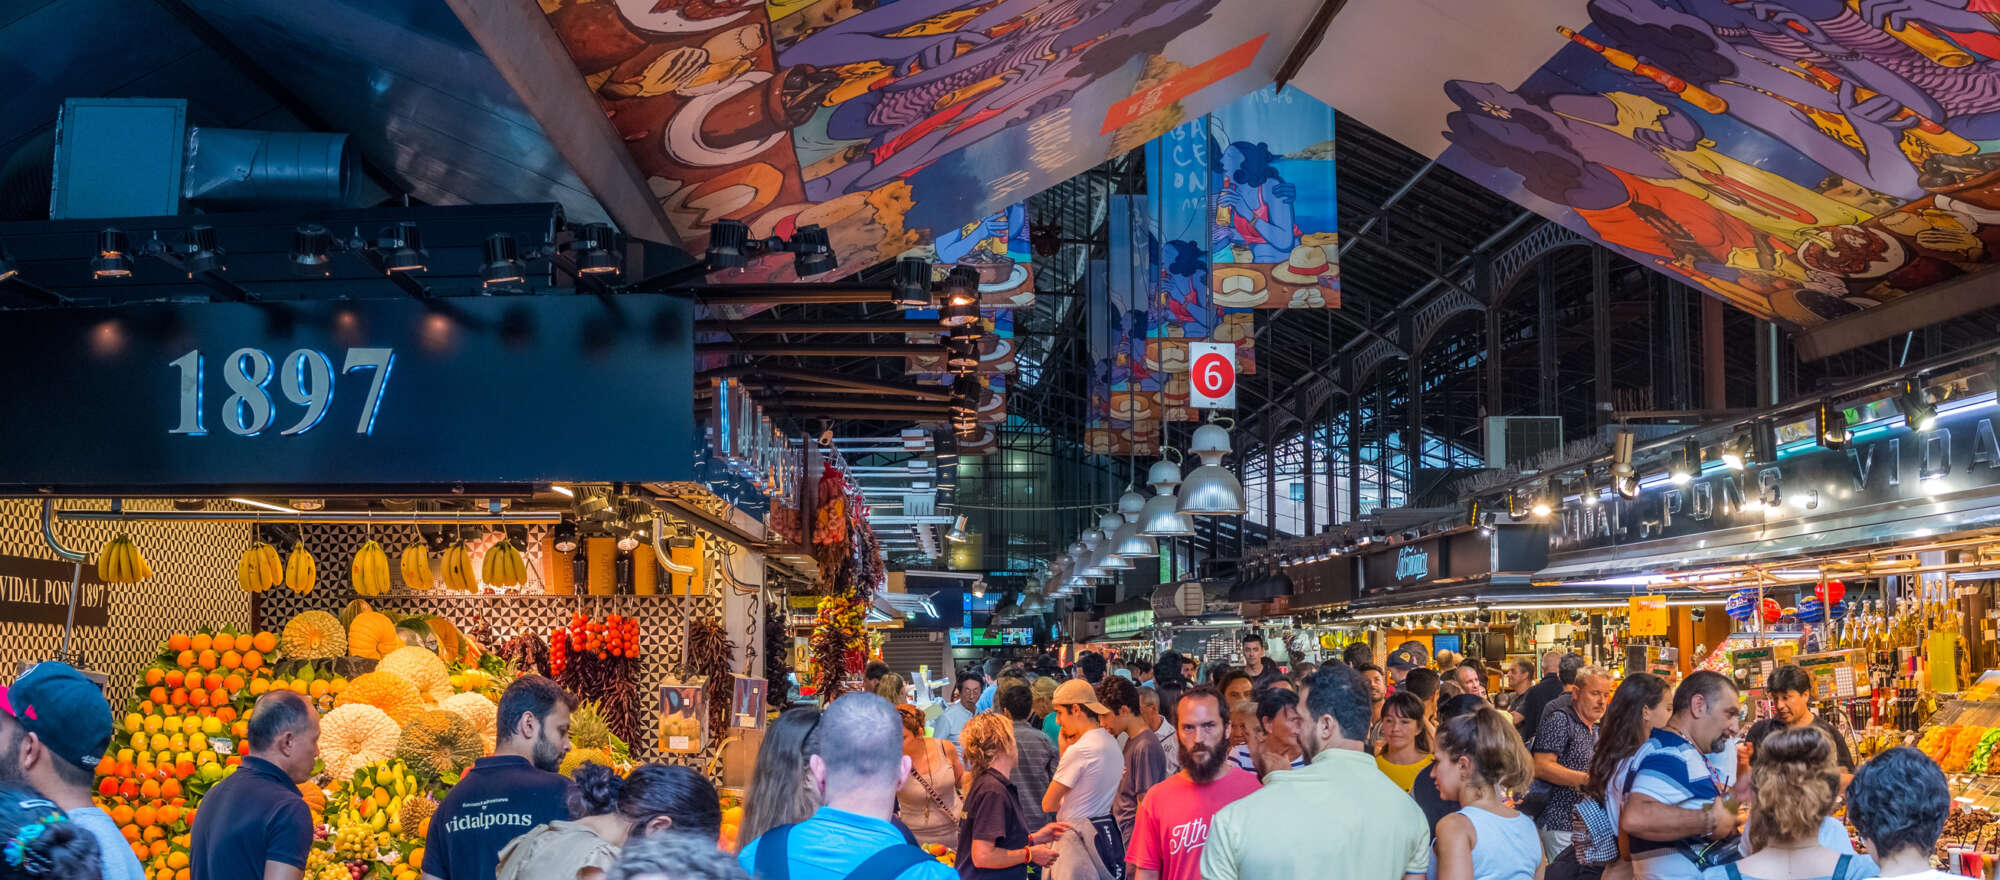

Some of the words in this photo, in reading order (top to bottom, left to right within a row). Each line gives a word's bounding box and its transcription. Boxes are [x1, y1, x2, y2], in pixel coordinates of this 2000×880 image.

[168, 347, 395, 435] 1897
[1204, 360, 1223, 391] 6
[0, 575, 41, 604] VIDAL
[44, 579, 75, 606] PON
[81, 583, 105, 608] 1897
